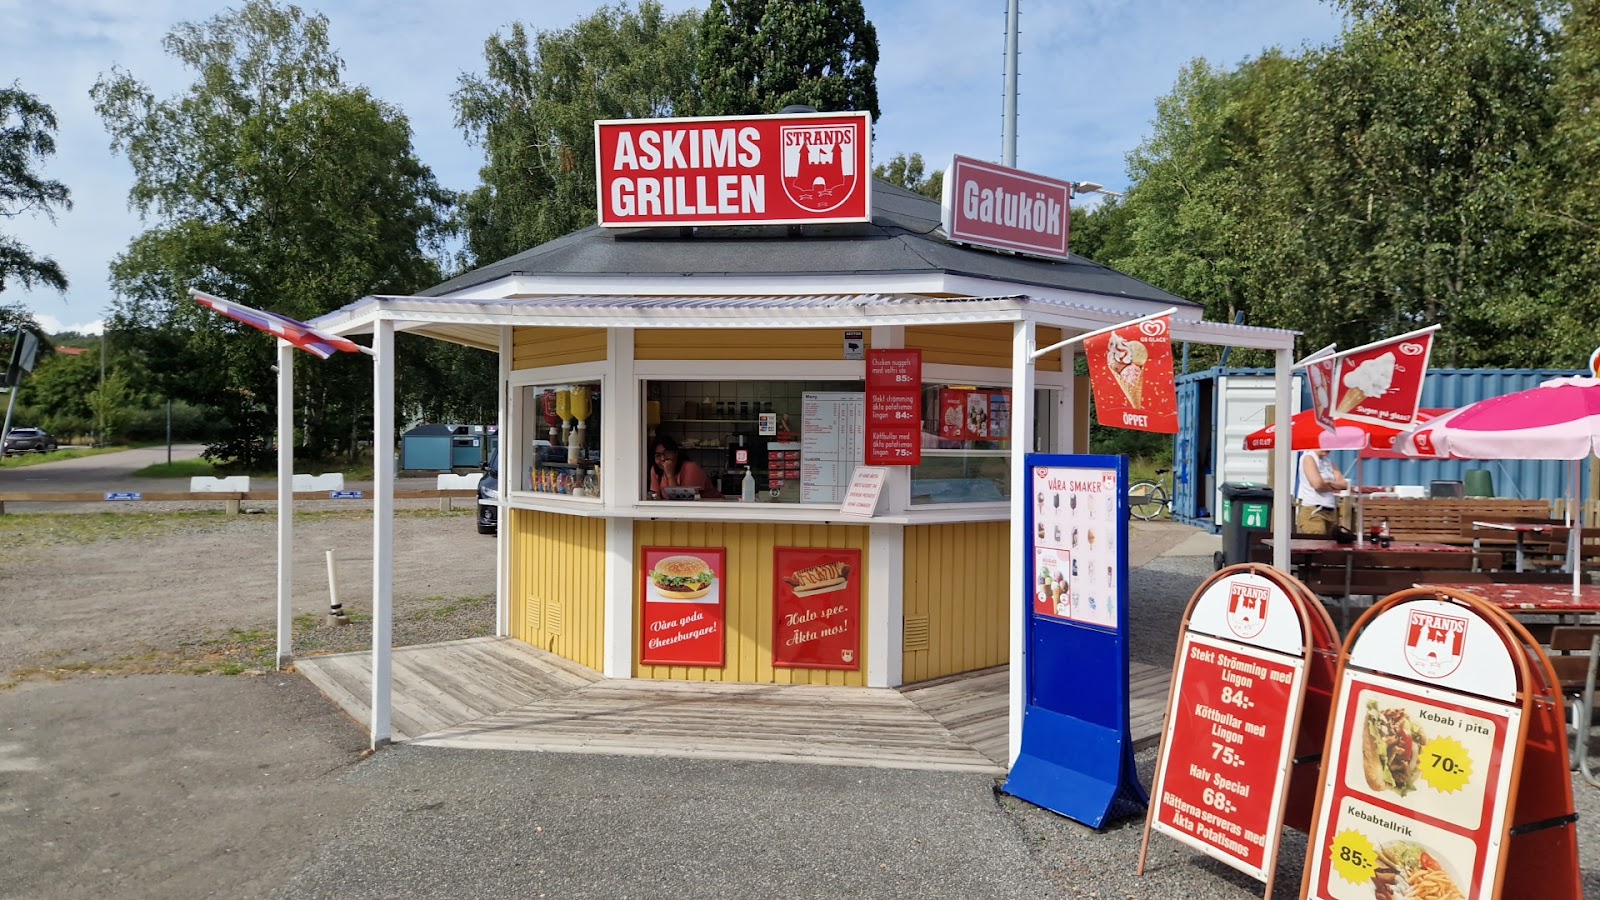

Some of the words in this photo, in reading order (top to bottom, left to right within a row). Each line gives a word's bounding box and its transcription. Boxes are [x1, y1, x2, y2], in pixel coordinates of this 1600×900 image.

[613, 127, 761, 170] ASKIMS
[786, 129, 852, 146] STRANDS
[611, 174, 766, 217] GRILLEN
[963, 179, 1061, 236] Gatukök
[872, 366, 884, 374] med
[892, 358, 911, 368] nuggets
[895, 374, 914, 382] 85:-
[872, 394, 886, 403] Stekt
[895, 411, 914, 419] 84:-
[1122, 411, 1149, 428] ÖPPET
[898, 431, 911, 440] med
[895, 449, 913, 457] 75:-
[1048, 477, 1066, 491] VÅRA
[1069, 480, 1102, 493] SMAKER
[1231, 585, 1268, 600] STRANDS
[650, 620, 678, 632] Våra
[679, 611, 704, 627] goda
[820, 604, 848, 619] spec.
[786, 629, 819, 647] Äkta
[820, 619, 848, 638] mos!
[1411, 614, 1465, 634] STRANDS
[648, 621, 718, 650] Cheeseburgare!
[1190, 646, 1215, 664] Stekt
[1217, 653, 1268, 681] Strömming
[1269, 669, 1293, 685] med
[1221, 668, 1253, 688] Lingon
[1220, 686, 1254, 710] 84:-
[1195, 703, 1242, 729] Köttbullar
[1244, 720, 1266, 737] med
[1419, 709, 1455, 727] Kebab
[1458, 718, 1462, 728] i
[1465, 721, 1490, 736] pita
[1211, 723, 1244, 745] Lingon
[1211, 742, 1245, 768] 75:-
[1430, 753, 1465, 775] 70:-
[1189, 763, 1211, 782] Halv
[1213, 772, 1250, 798] Special
[1202, 787, 1237, 814] 68:-
[1347, 805, 1412, 837] Kebabtallrik
[1172, 808, 1194, 833] Äkta
[1196, 822, 1250, 858] Potatismos
[1244, 829, 1267, 848] med
[1339, 846, 1373, 869] 85:-
